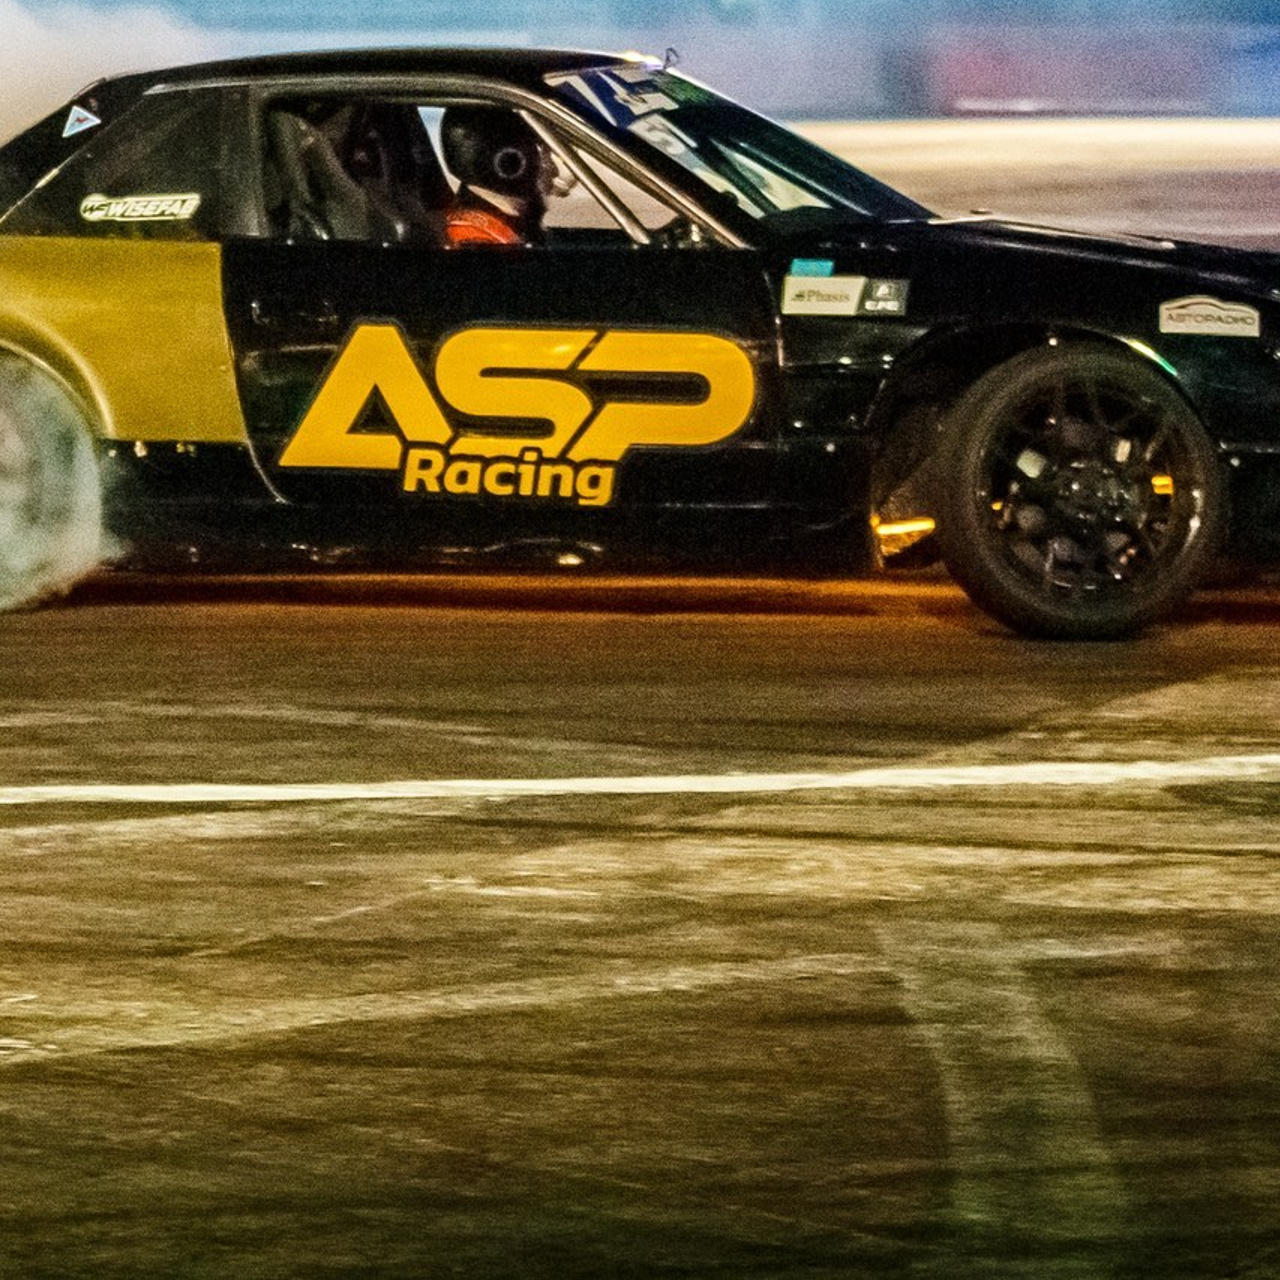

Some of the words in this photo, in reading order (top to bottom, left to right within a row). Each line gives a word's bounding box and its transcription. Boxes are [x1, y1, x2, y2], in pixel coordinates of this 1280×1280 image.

[107, 198, 198, 217] WISEFAB
[279, 325, 755, 470] ASP
[404, 447, 615, 506] Racing
